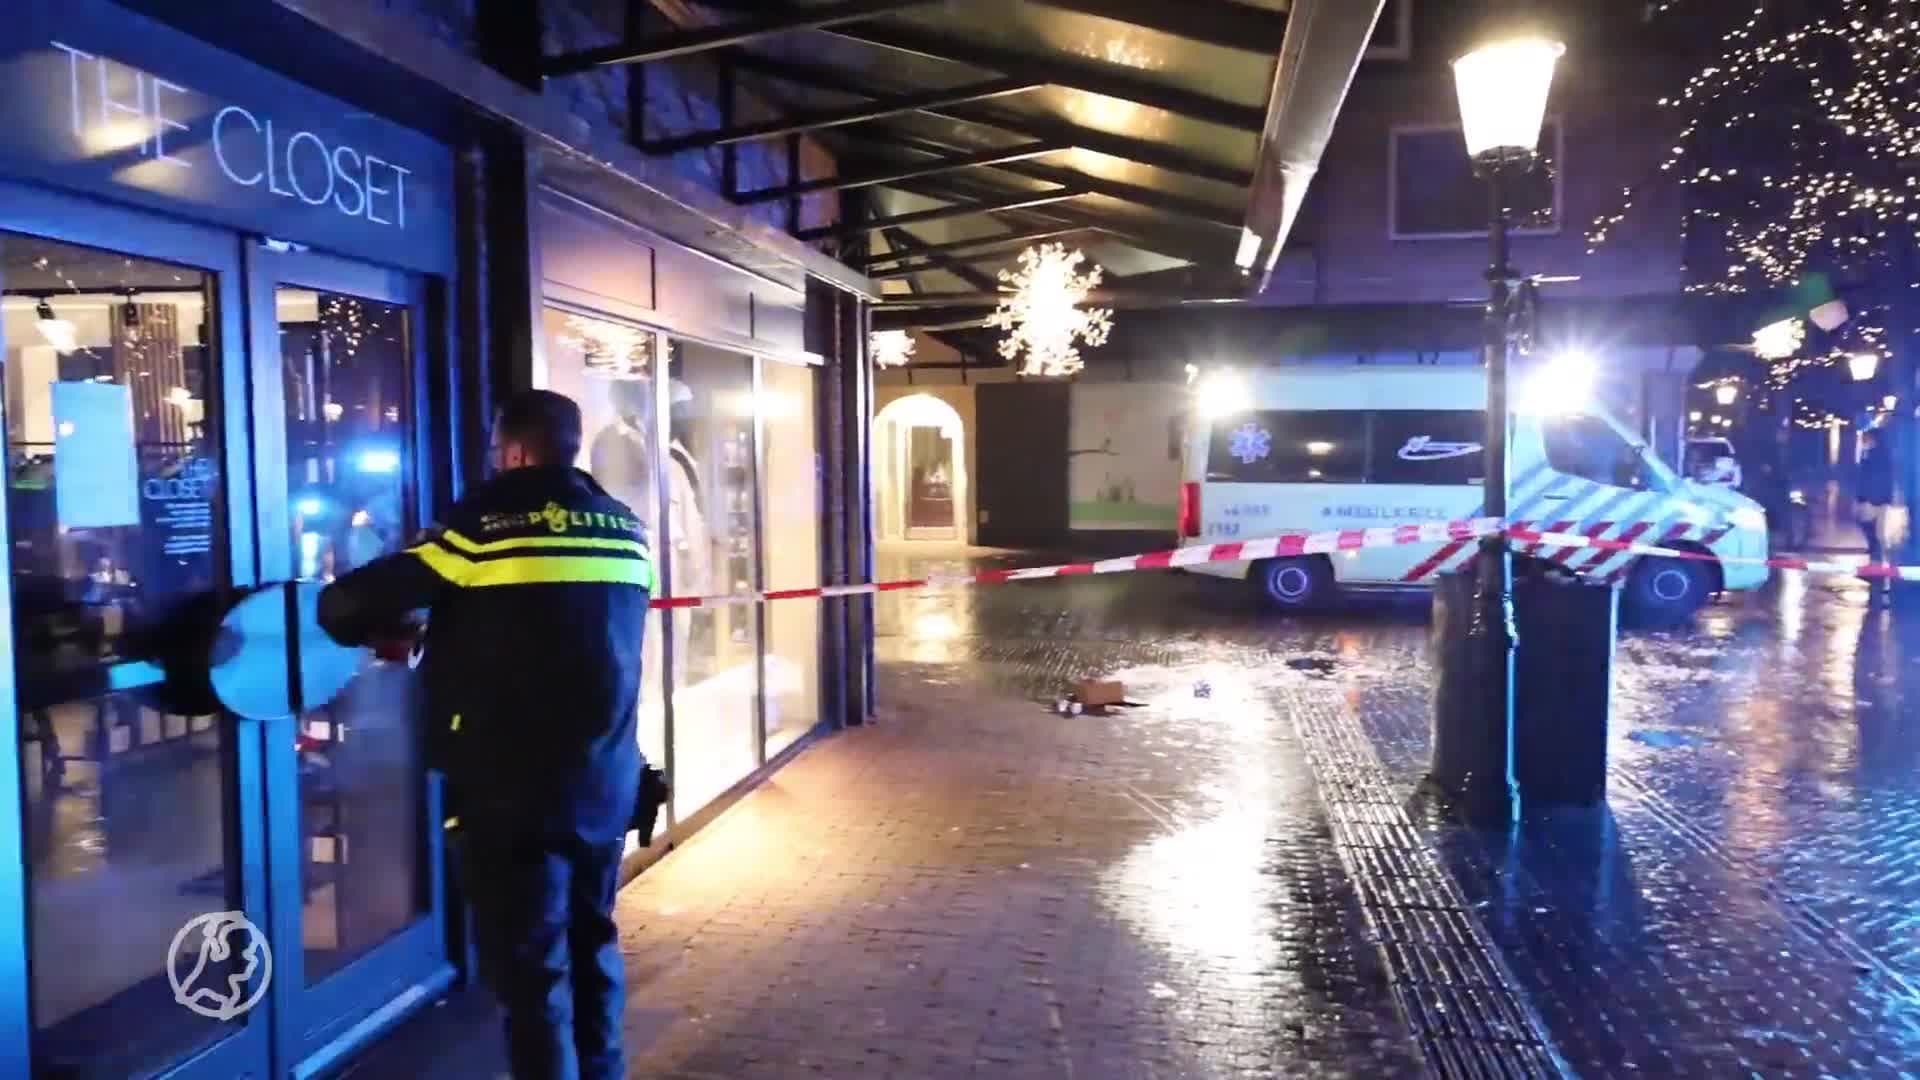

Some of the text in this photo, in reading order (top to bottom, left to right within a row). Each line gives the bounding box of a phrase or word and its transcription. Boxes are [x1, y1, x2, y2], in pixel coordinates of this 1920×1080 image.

[50, 40, 411, 229] THE CLOSET
[143, 477, 212, 500] CLOSE
